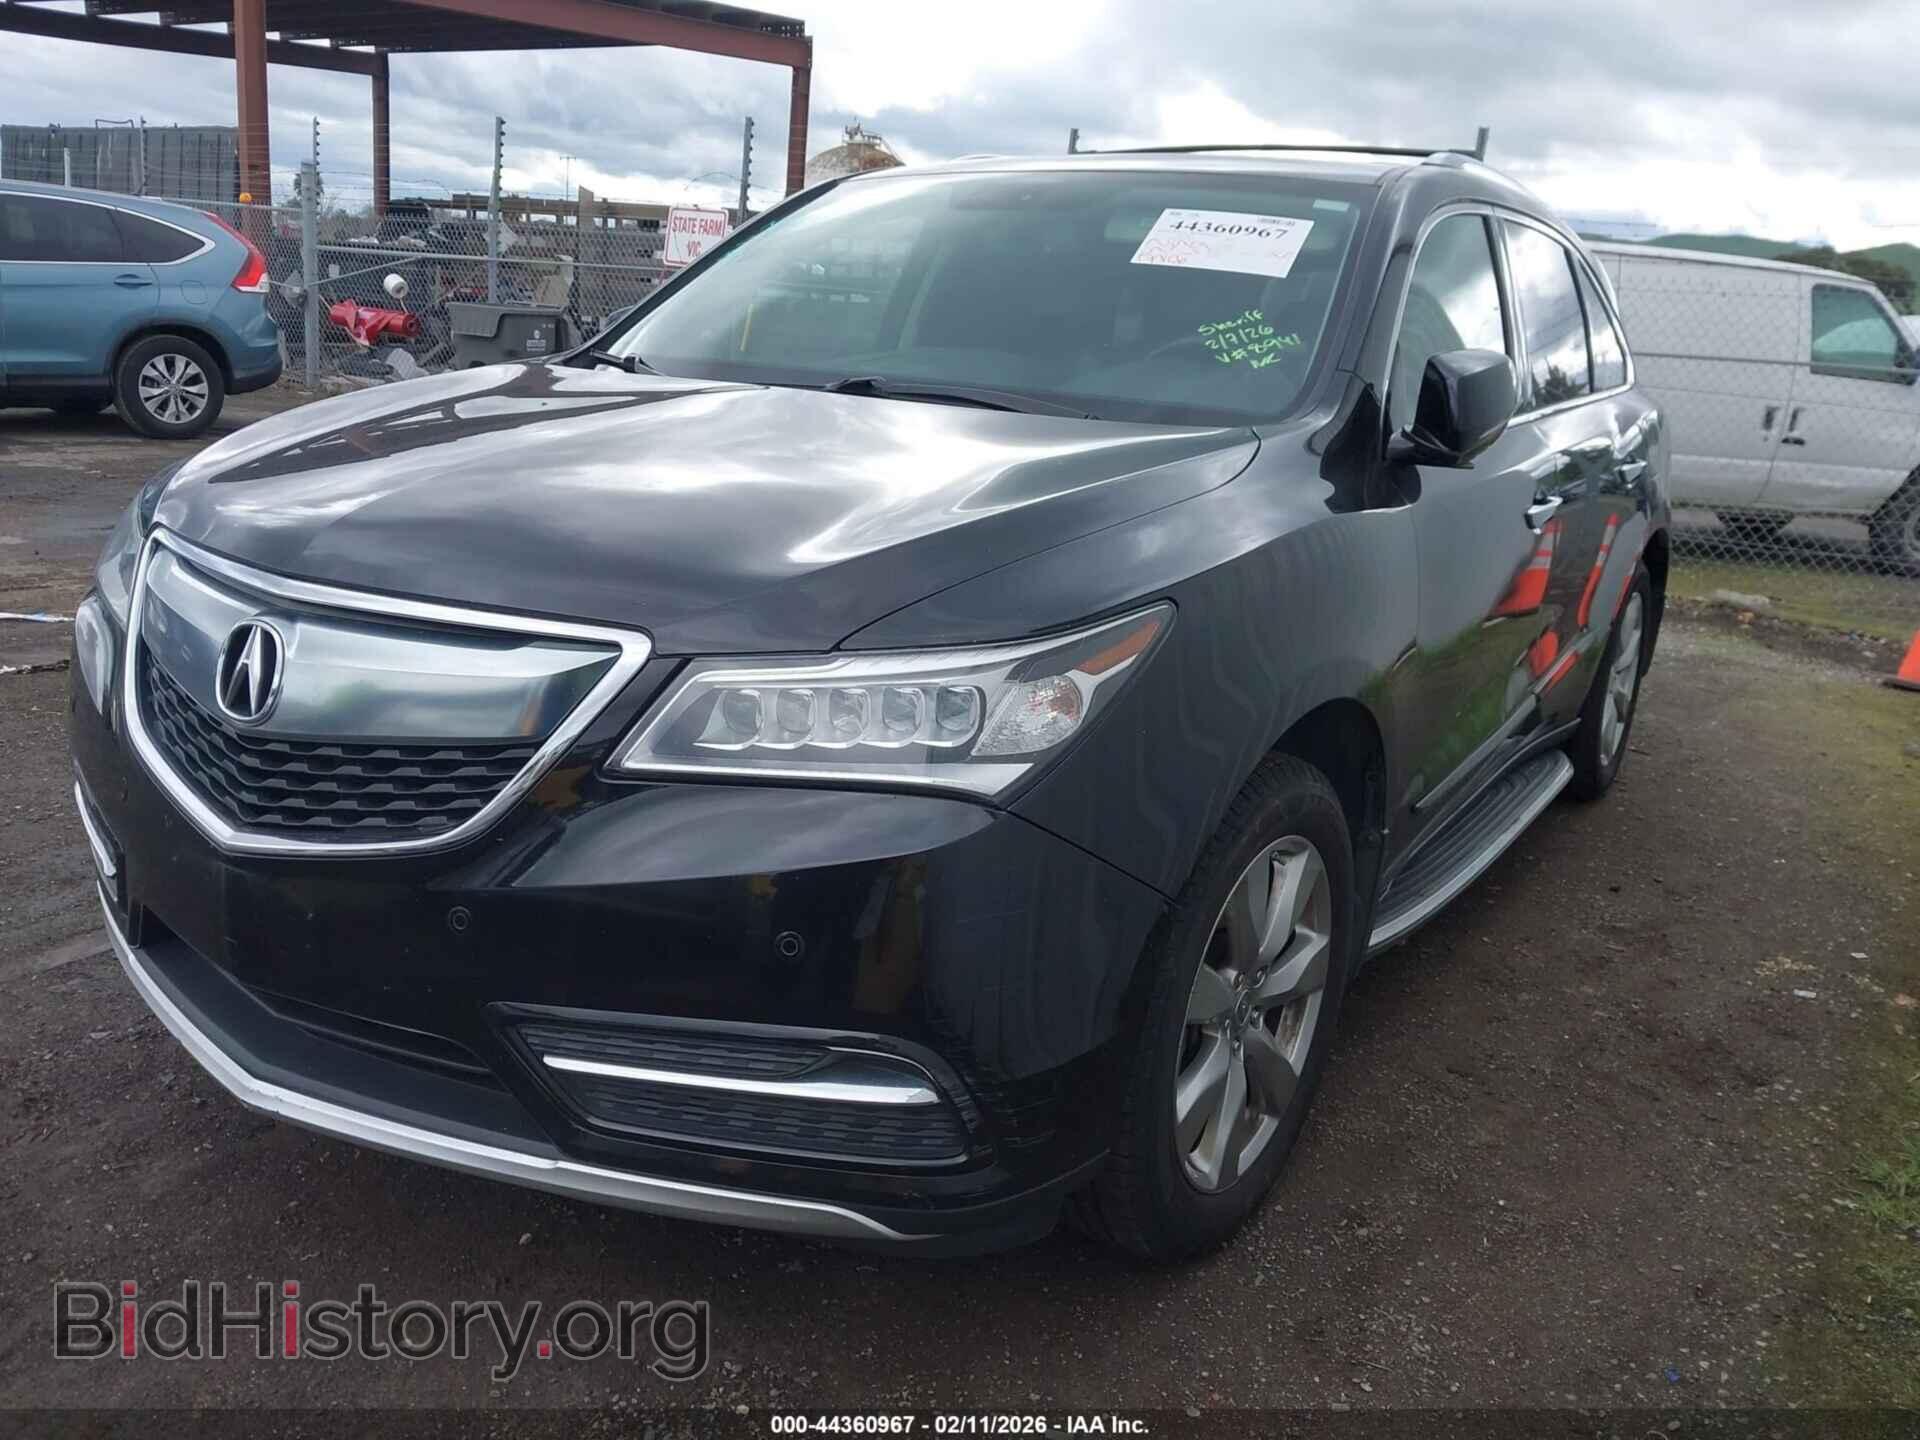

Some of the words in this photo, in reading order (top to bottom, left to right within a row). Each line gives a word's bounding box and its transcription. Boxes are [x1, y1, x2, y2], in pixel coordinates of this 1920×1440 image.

[671, 216, 698, 234] STATE
[698, 219, 723, 236] FARM
[1169, 220, 1288, 240] 44360967
[1205, 324, 1274, 350] 2/7/26
